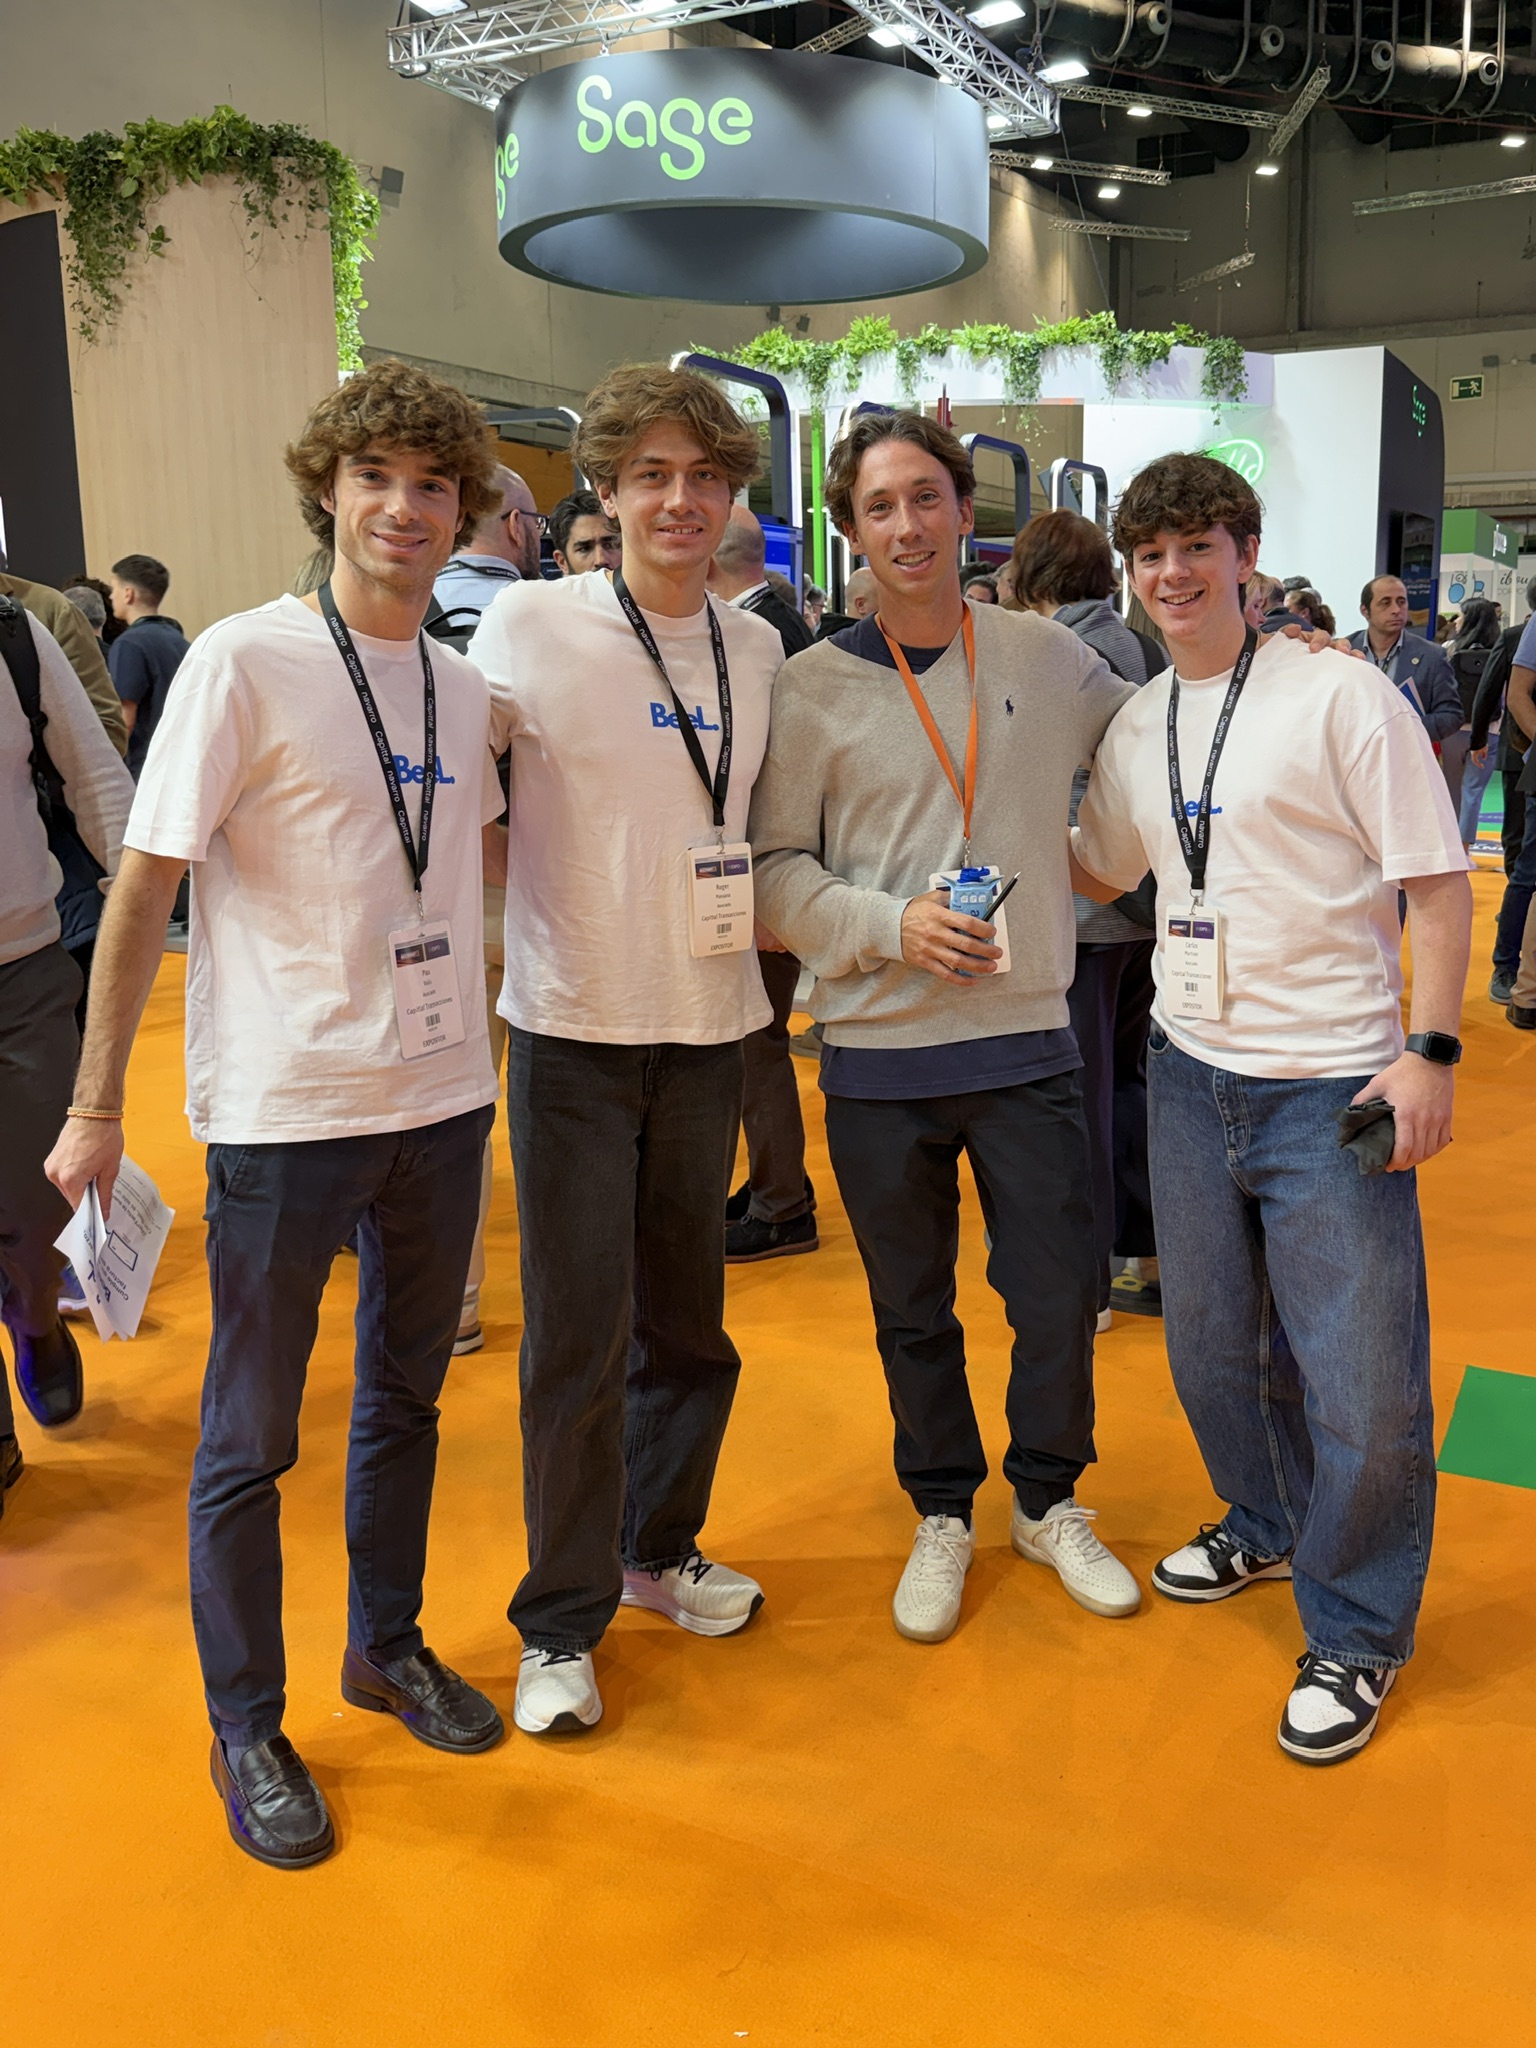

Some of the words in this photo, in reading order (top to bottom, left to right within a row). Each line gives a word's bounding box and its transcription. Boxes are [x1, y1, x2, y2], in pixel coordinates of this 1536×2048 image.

[576, 74, 754, 181] Sage
[621, 596, 641, 626] Capittal
[639, 628, 657, 655] navarro
[1235, 651, 1251, 680] Capittal
[720, 679, 730, 708] Capittal
[1225, 682, 1239, 710] navarro
[427, 697, 435, 730] Capittal
[330, 616, 348, 647] navarro
[345, 653, 366, 686] Capittal
[361, 691, 377, 724] navarro
[375, 730, 392, 765] Capittal
[387, 770, 400, 803] navarro
[397, 809, 412, 844] Capittal
[1214, 715, 1229, 744] Capittal
[719, 745, 731, 775] Capittal
[1206, 749, 1218, 777] navarro
[424, 771, 434, 804] Capittal
[1170, 761, 1179, 789] Capittal
[1174, 793, 1184, 821] navarro
[1200, 784, 1210, 814] Capittal
[421, 809, 429, 842] navarro
[1197, 820, 1206, 849] navarro
[1180, 826, 1194, 856] Capittal
[710, 942, 734, 951] EXPOSITOR
[422, 1034, 447, 1048] EXPOSITOR
